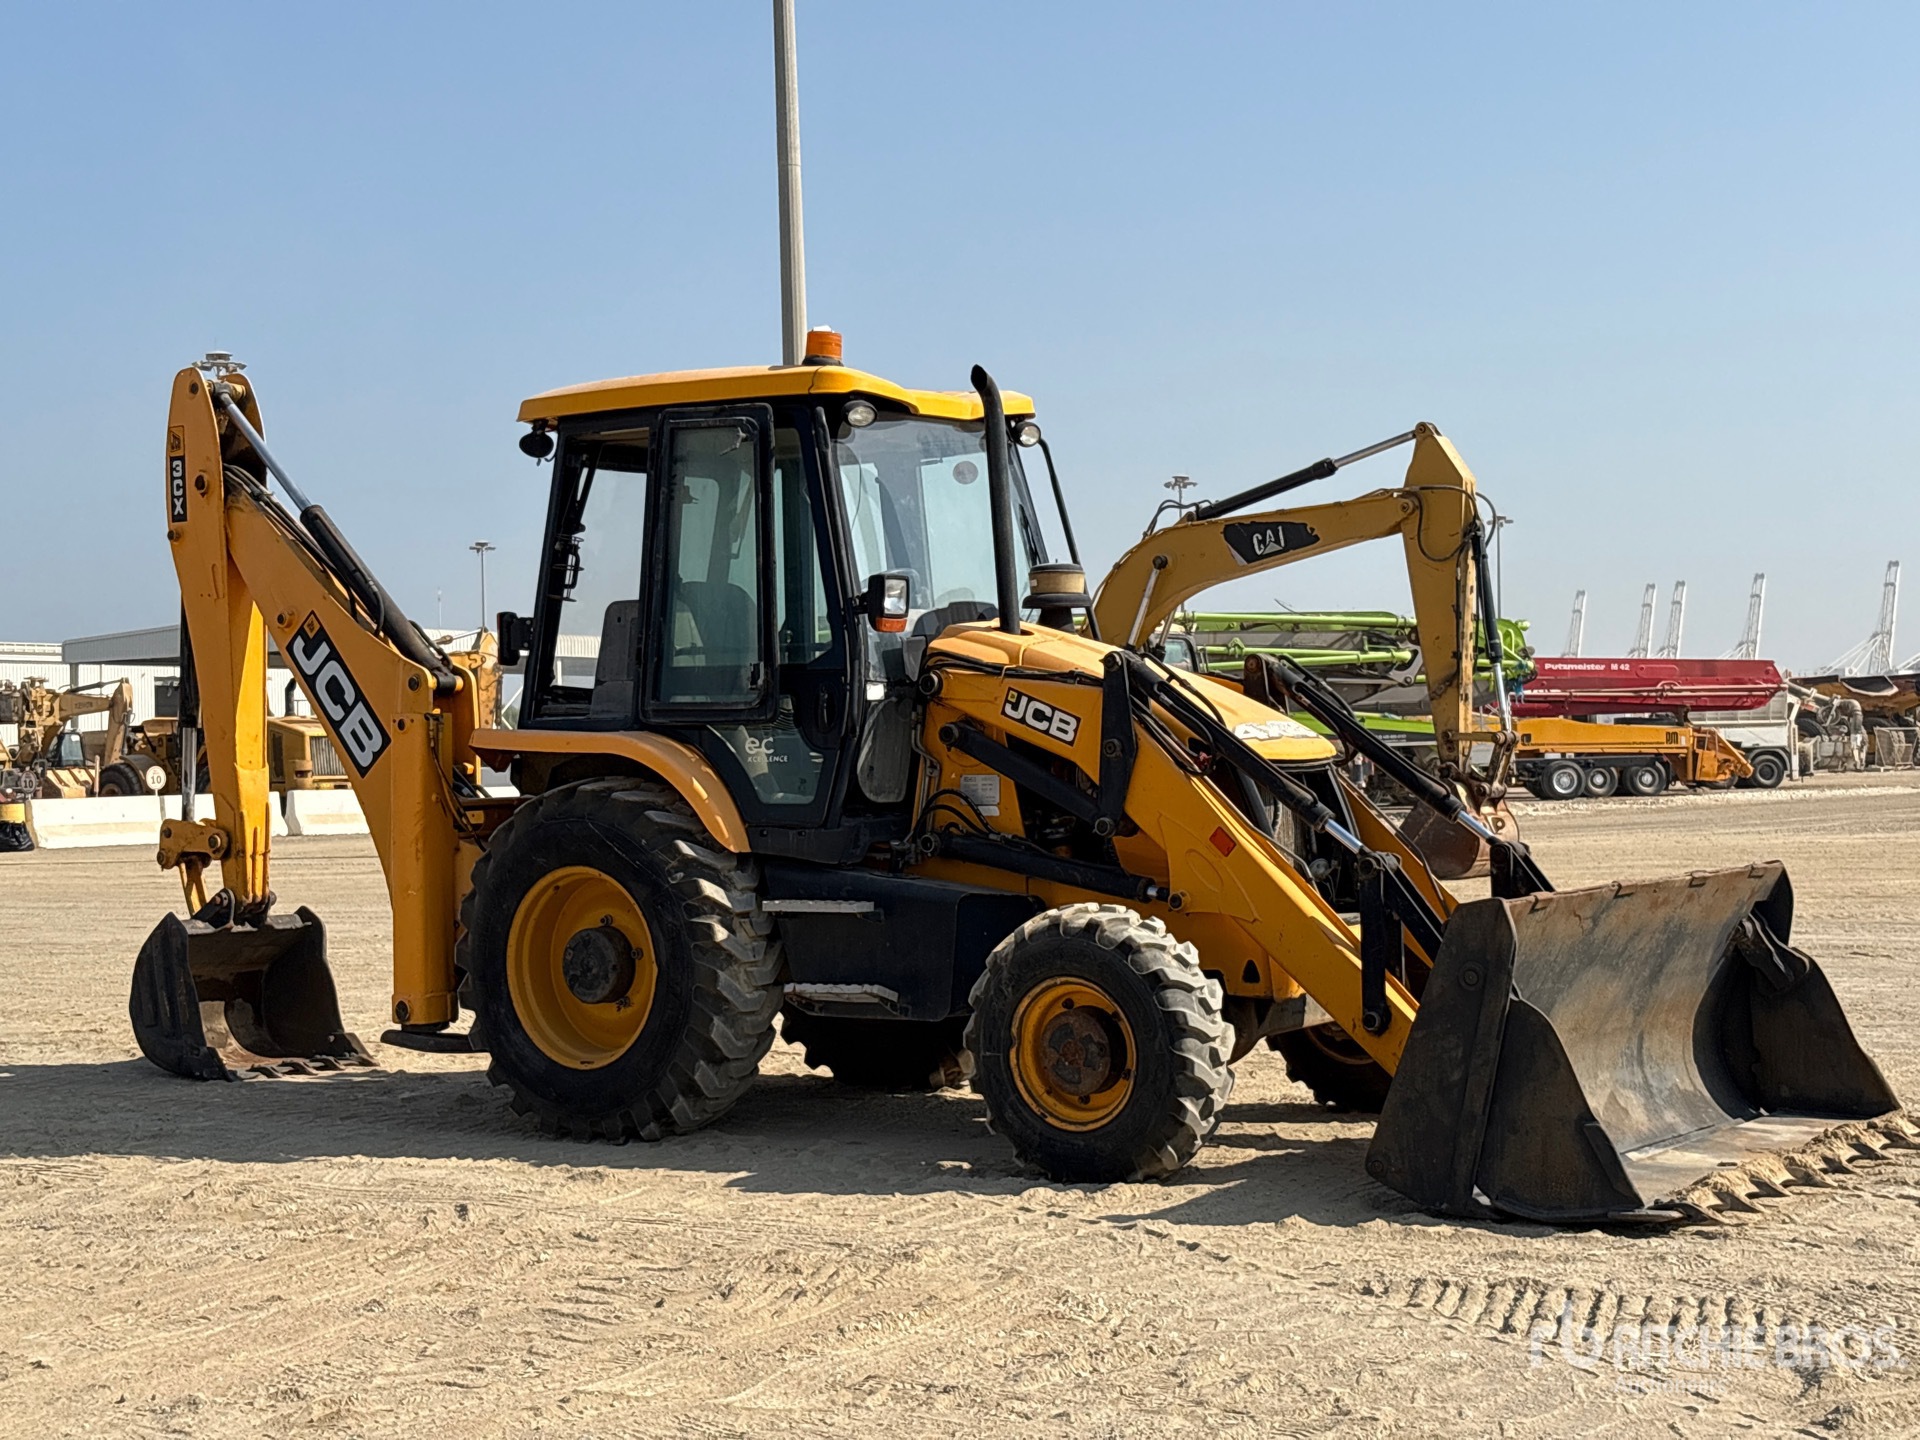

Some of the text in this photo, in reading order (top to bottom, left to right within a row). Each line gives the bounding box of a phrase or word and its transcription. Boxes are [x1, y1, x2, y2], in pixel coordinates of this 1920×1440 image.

[171, 460, 184, 515] 3CX
[1544, 663, 1606, 671] Putzmeister
[1620, 663, 1630, 671] 42
[293, 635, 383, 768] JCB
[1004, 695, 1077, 742] JCB
[23, 779, 34, 789] 10
[150, 775, 162, 785] 10
